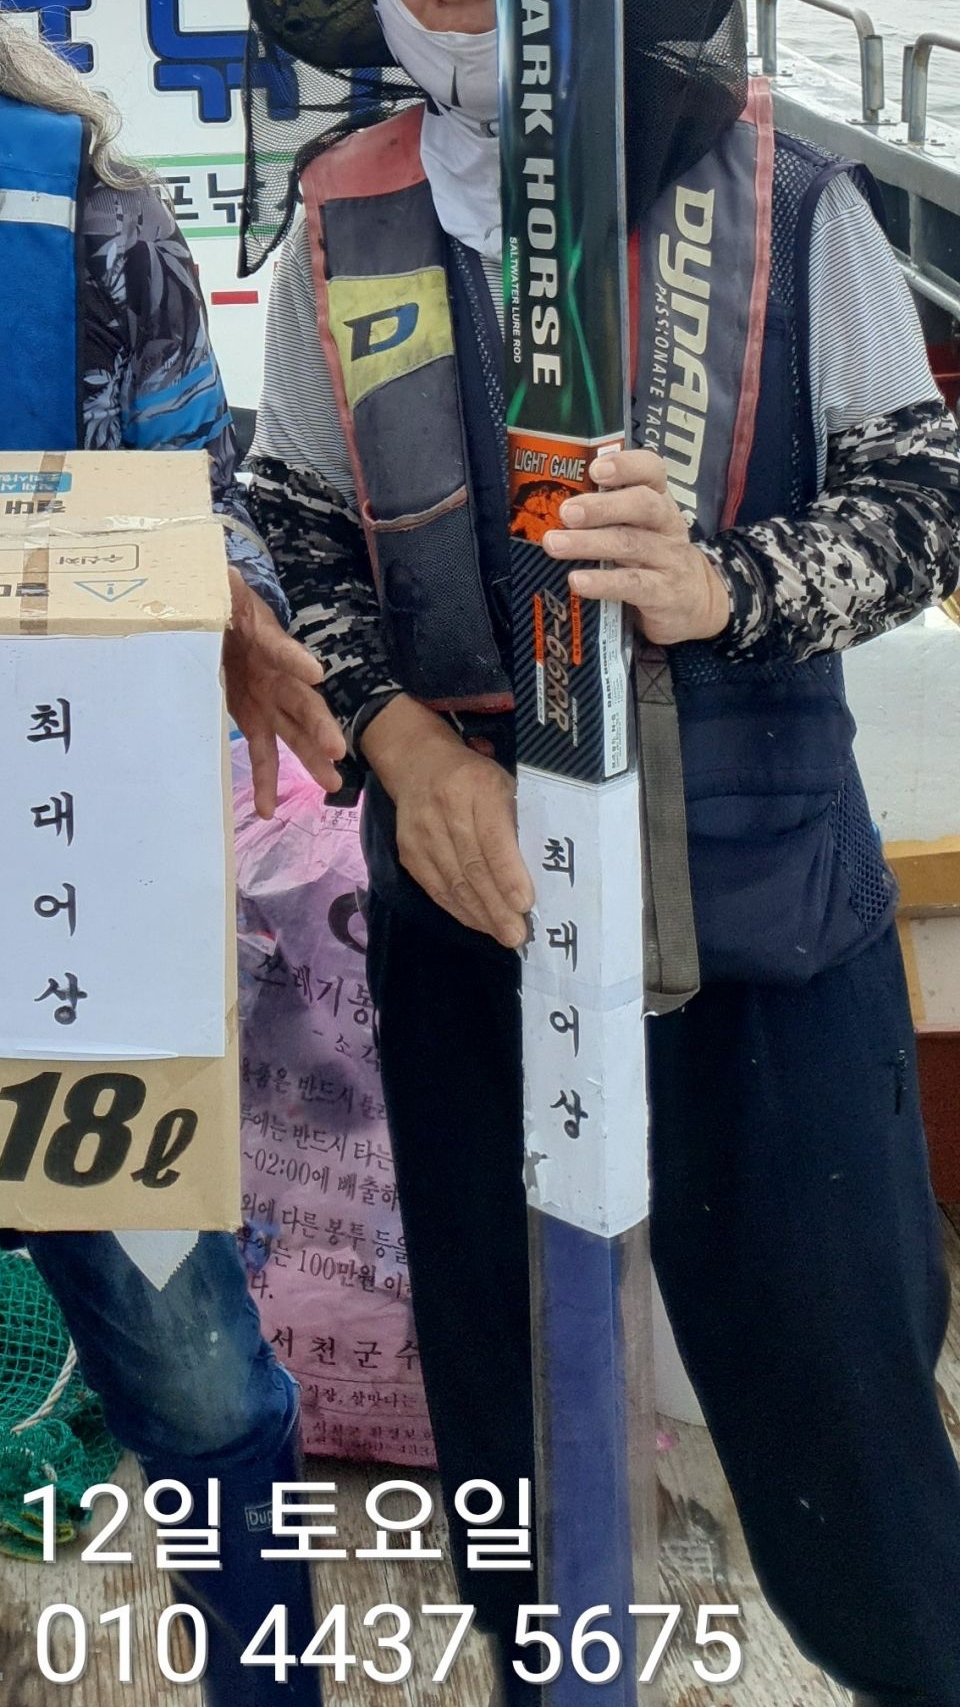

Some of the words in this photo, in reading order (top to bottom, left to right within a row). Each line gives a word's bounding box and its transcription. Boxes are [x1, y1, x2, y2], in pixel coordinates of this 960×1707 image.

[509, 236, 520, 304] SALTWATER
[522, 157, 561, 388] HORSE
[511, 306, 522, 336] LURE
[650, 282, 668, 398] PASSIONATE
[512, 338, 522, 364] ROD
[514, 448, 548, 474] LIGHT
[549, 455, 586, 482] GAME
[298, 1073, 354, 1113] 반드시
[293, 1123, 347, 1161] 반드시
[282, 1205, 320, 1239] 다른
[325, 1218, 366, 1250] 봉투
[297, 1249, 376, 1293] 100만원
